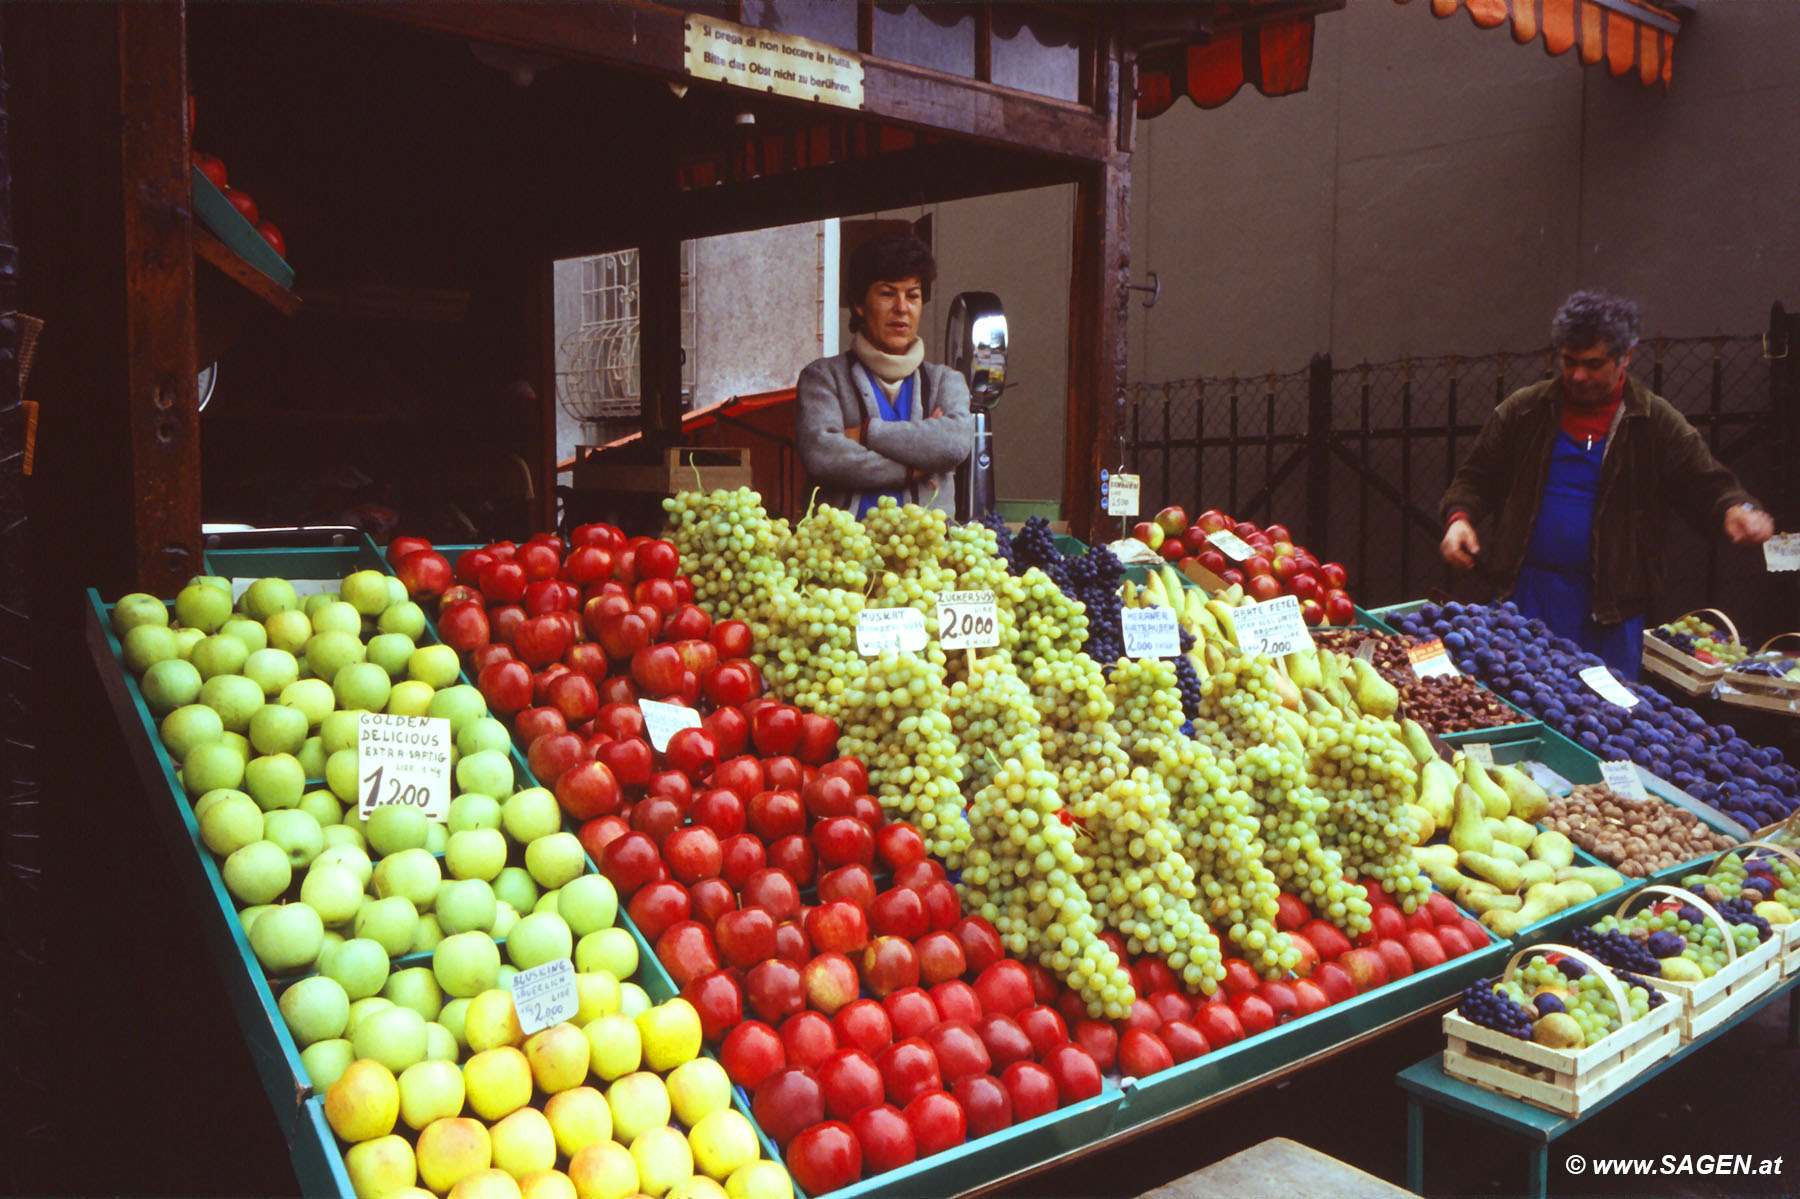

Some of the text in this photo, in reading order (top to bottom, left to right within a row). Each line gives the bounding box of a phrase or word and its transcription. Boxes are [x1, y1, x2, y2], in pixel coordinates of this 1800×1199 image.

[703, 24, 712, 37] Si
[714, 30, 743, 47] prega
[746, 36, 757, 48] di
[759, 40, 779, 53] non
[781, 44, 815, 61] toccare
[816, 51, 826, 64] la
[703, 51, 852, 94] Bitte das Obst nicht zu berühren.
[861, 610, 905, 622] MUSKAT
[1233, 599, 1297, 620] ABATE FETEL
[360, 713, 431, 728] GOLDEN
[360, 729, 440, 747] DELICIOUS
[365, 746, 447, 763] EXTRA SAFTIG
